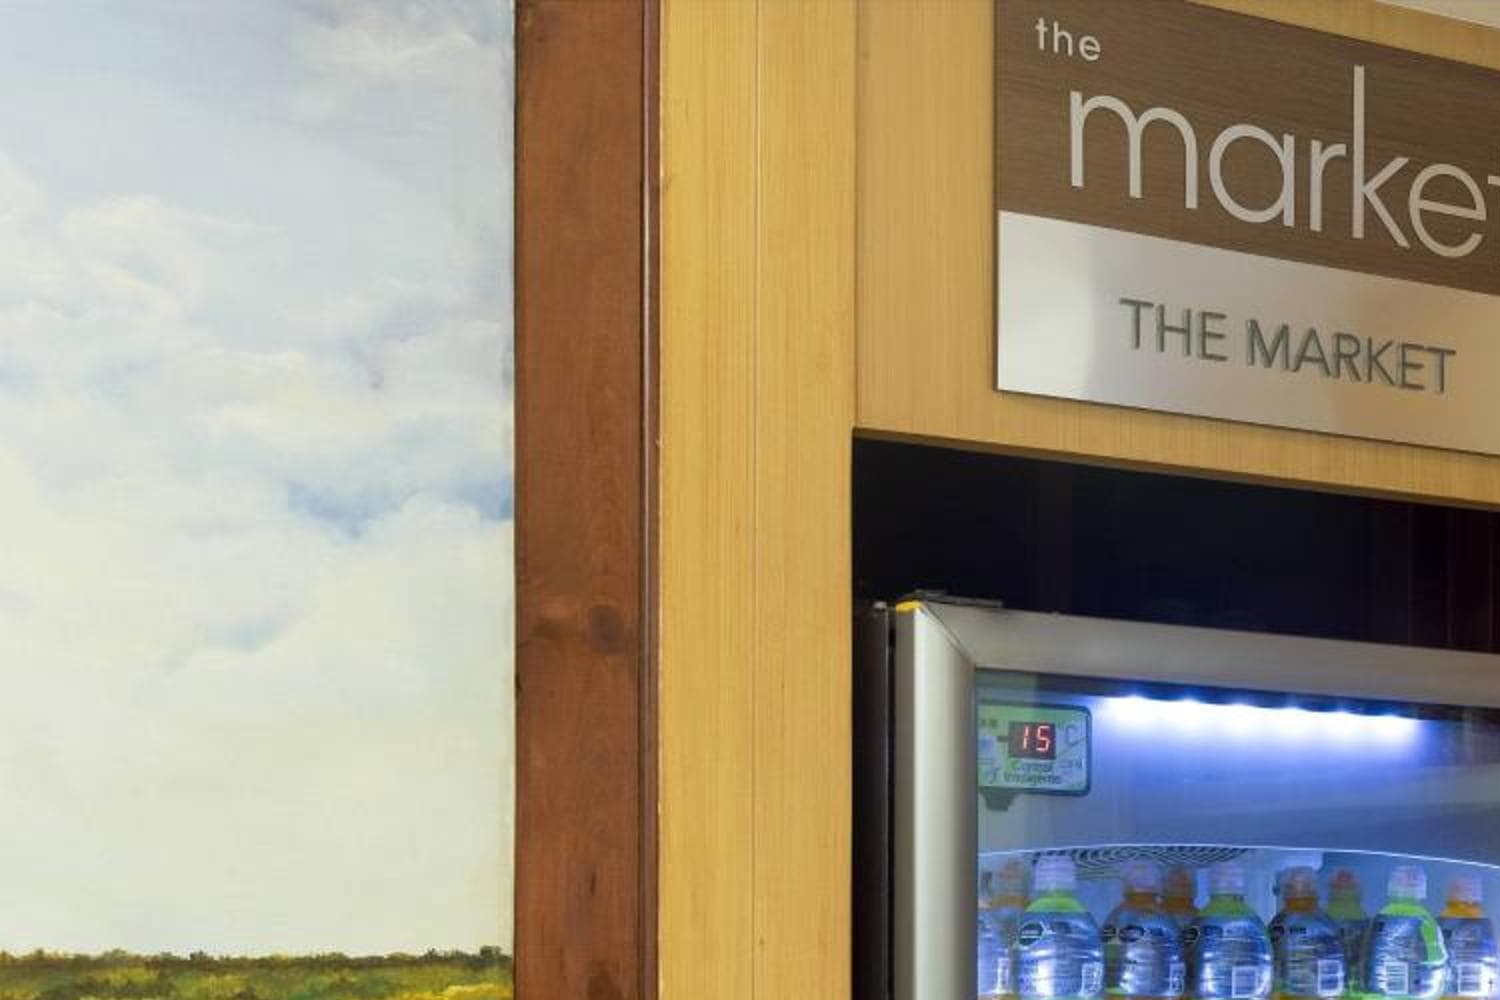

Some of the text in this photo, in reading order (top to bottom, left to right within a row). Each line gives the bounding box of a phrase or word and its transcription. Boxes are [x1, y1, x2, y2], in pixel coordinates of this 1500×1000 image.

[1035, 17, 1101, 62] the
[1119, 297, 1457, 395] THE MARKET
[1022, 725, 1051, 753] 15
